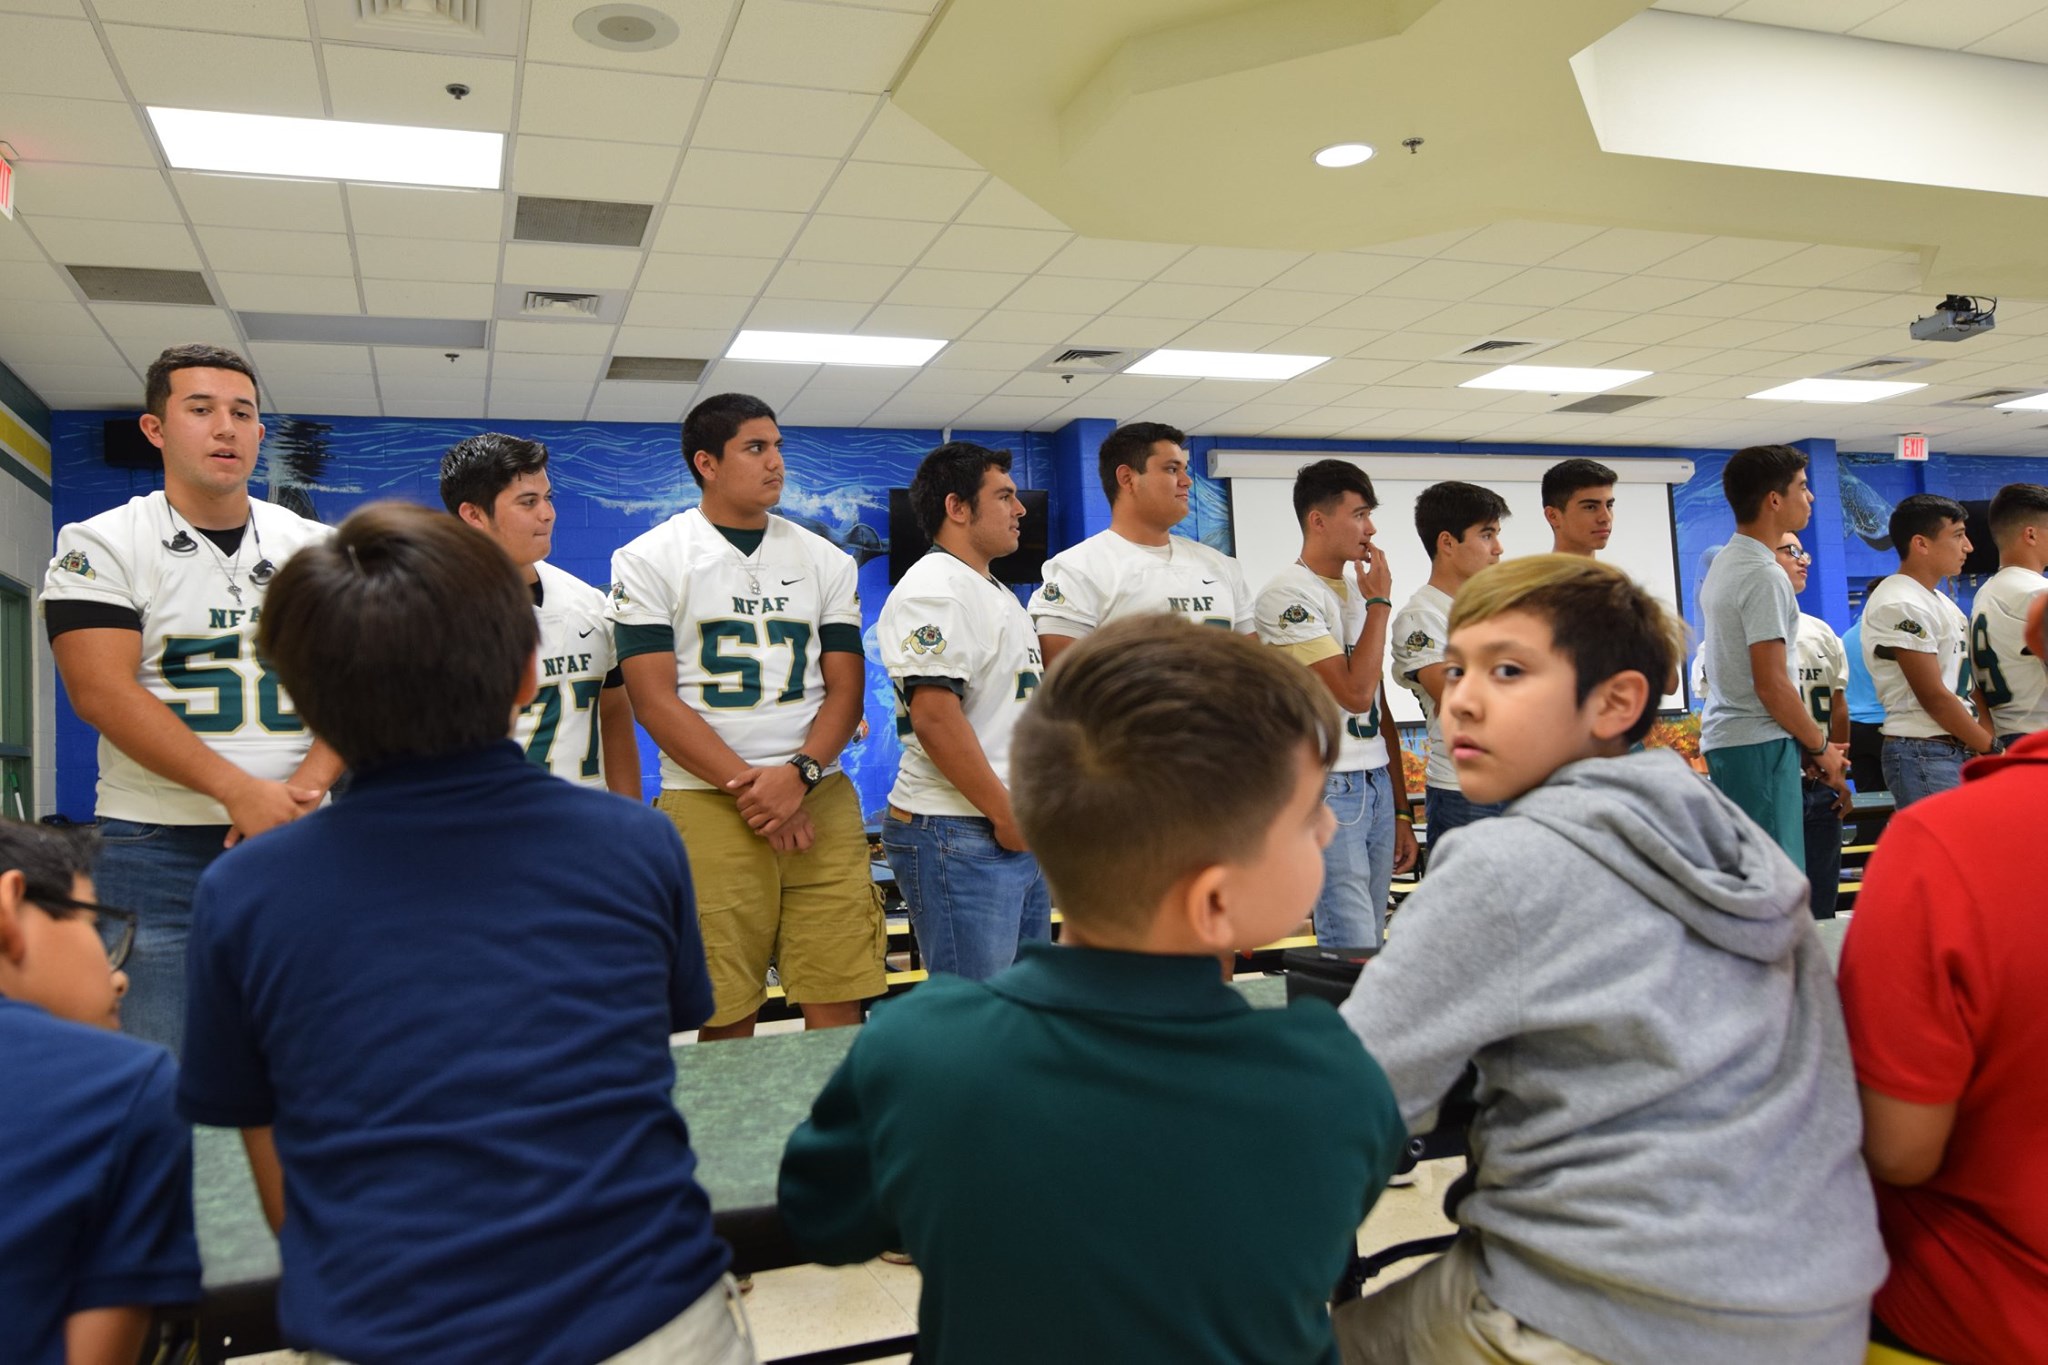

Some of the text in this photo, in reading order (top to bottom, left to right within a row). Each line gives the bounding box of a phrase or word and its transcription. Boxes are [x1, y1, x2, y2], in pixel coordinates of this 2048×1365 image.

[1903, 437, 1925, 458] EXIT
[732, 596, 789, 615] NFAF
[1168, 596, 1214, 612] NFAF
[209, 606, 263, 628] NFA
[542, 653, 592, 677] NFAF
[696, 617, 815, 711] 57
[518, 676, 604, 780] 77
